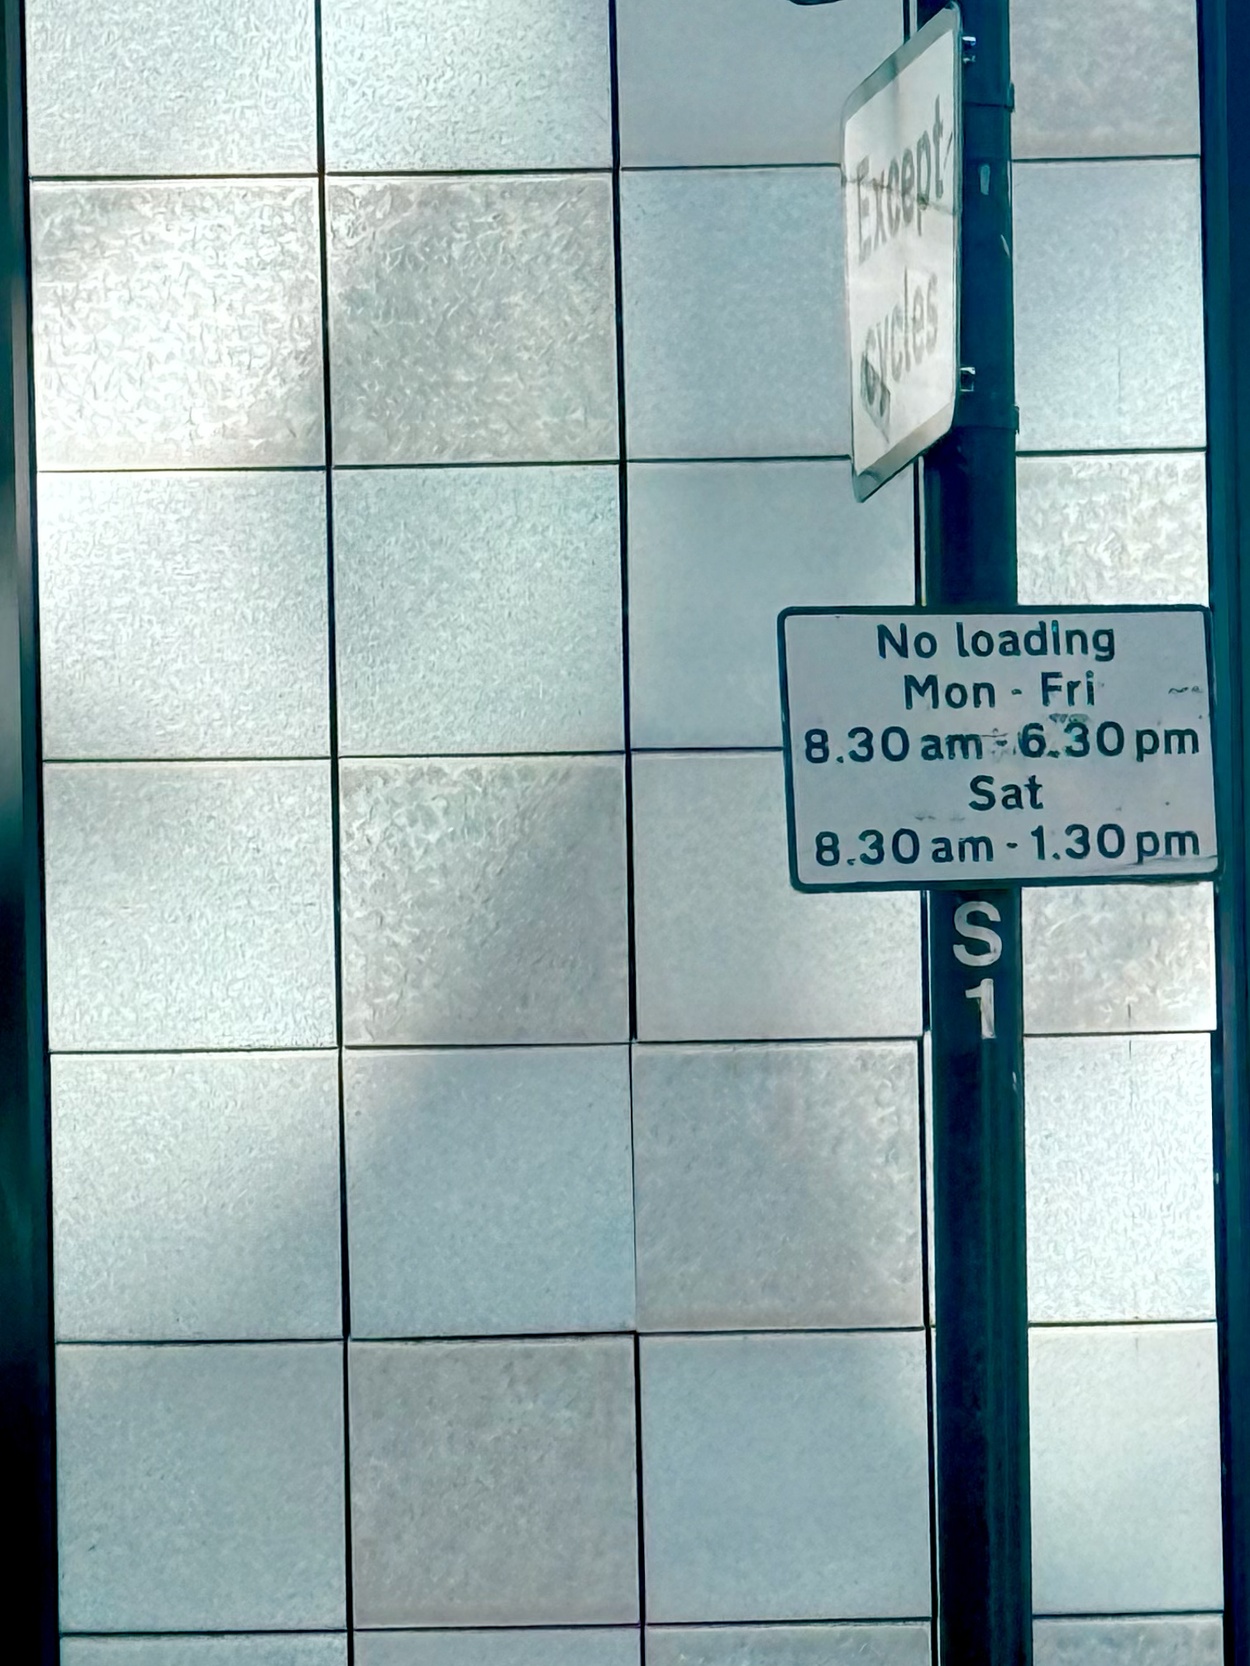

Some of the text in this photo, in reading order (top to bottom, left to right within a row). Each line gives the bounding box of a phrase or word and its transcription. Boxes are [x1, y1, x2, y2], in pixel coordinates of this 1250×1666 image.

[857, 94, 944, 266] Except
[876, 619, 1116, 663] No loading
[903, 674, 996, 711] Mon
[1040, 669, 1095, 707] Fri
[968, 773, 1044, 811] Sat
